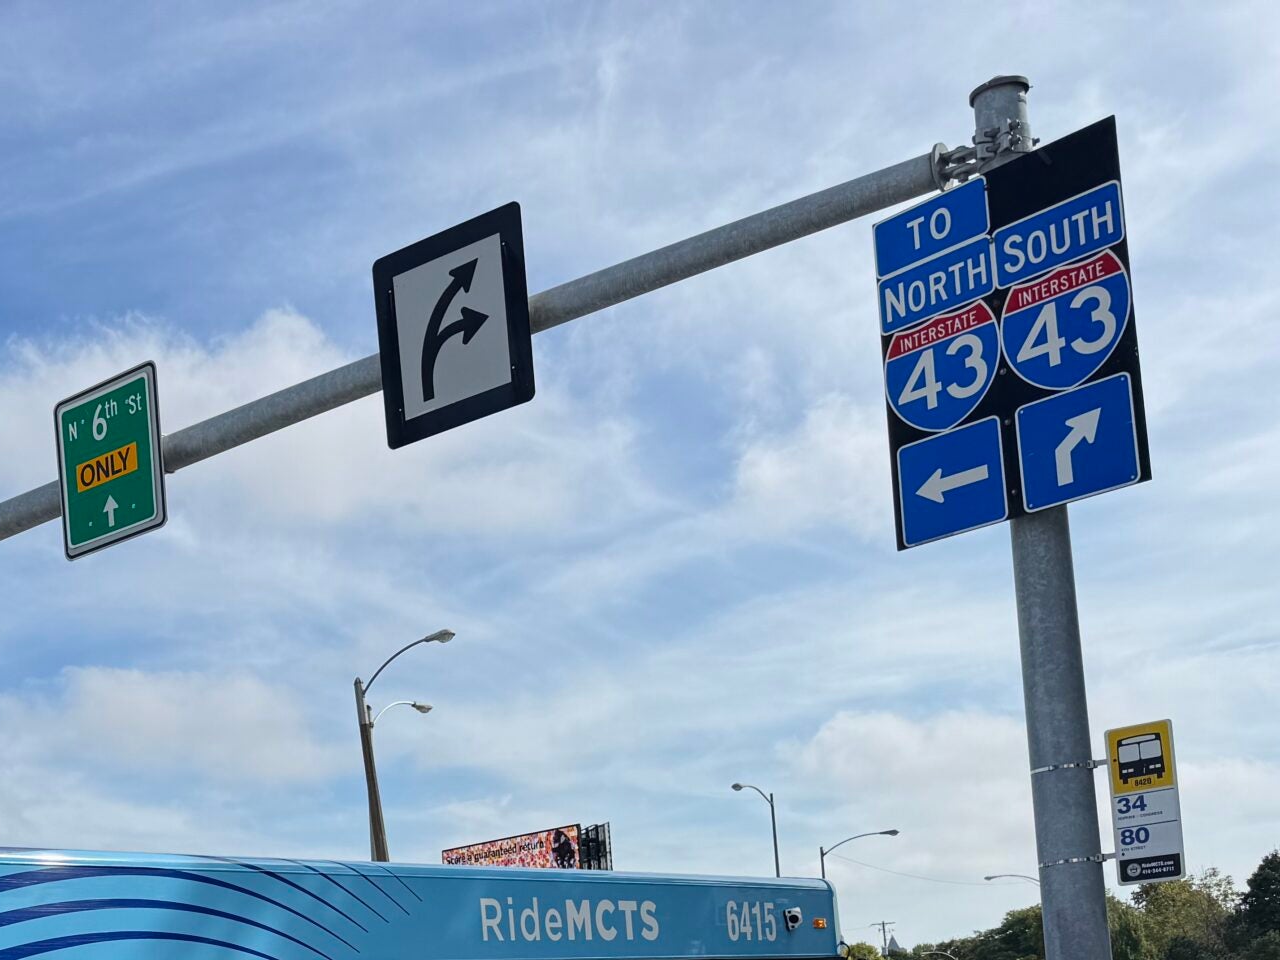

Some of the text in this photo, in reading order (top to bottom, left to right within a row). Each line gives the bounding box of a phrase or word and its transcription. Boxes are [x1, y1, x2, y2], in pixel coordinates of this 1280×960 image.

[906, 207, 952, 250] TO
[1003, 200, 1115, 273] SOUTH
[884, 253, 988, 323] NORTH
[1017, 260, 1106, 307] INTERSTATE
[899, 310, 978, 353] INTERSTATE
[1016, 285, 1117, 367] 43
[898, 334, 988, 410] 43
[68, 393, 142, 441] N 6th St
[80, 447, 130, 487] ONLY
[1117, 795, 1147, 814] 34
[446, 855, 465, 865] Score
[474, 843, 517, 863] guaranteed
[519, 840, 545, 853] return
[1120, 827, 1150, 846] 80
[479, 897, 660, 942] RideMCTS
[726, 900, 777, 942] 6415
